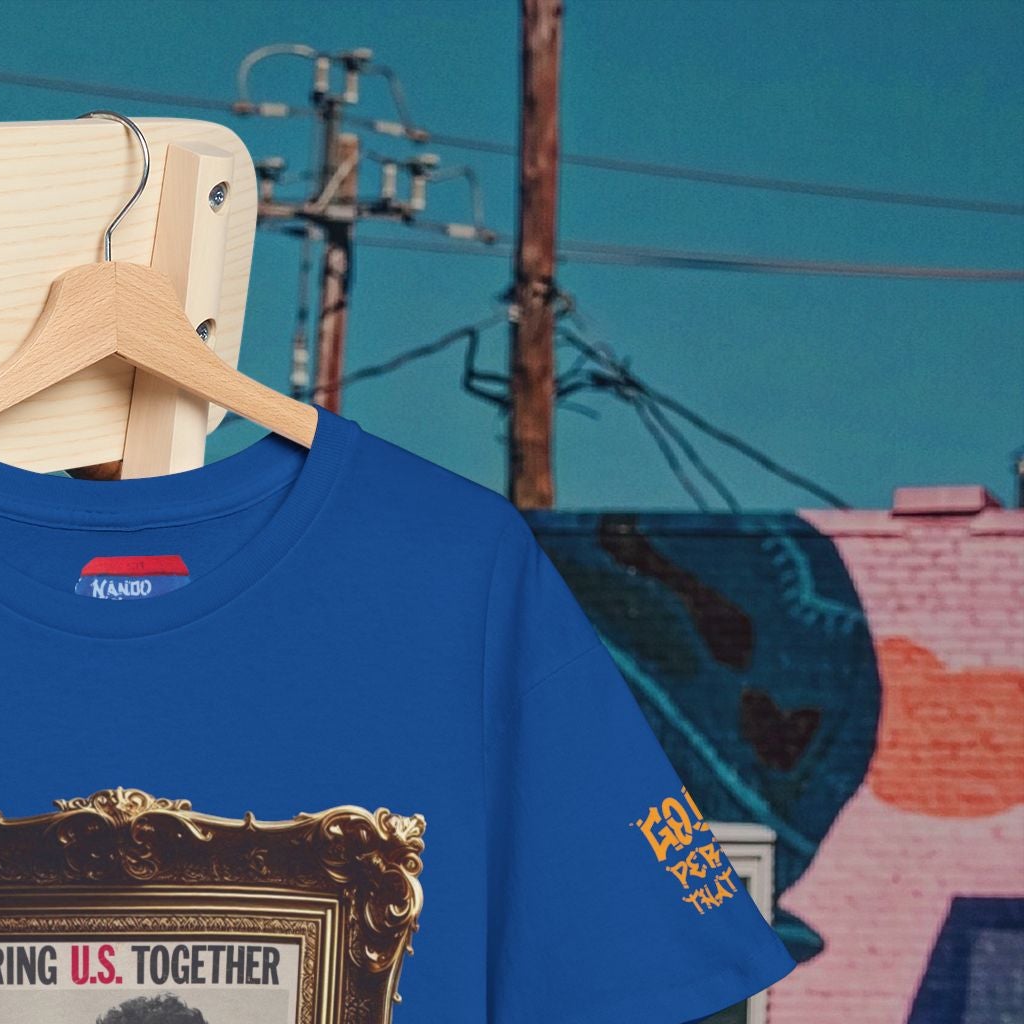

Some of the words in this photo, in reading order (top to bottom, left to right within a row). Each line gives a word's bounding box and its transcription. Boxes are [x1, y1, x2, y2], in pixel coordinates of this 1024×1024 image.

[91, 579, 152, 599] NANDO
[71, 944, 123, 985] U.S.
[131, 944, 280, 985] TOGETHER
